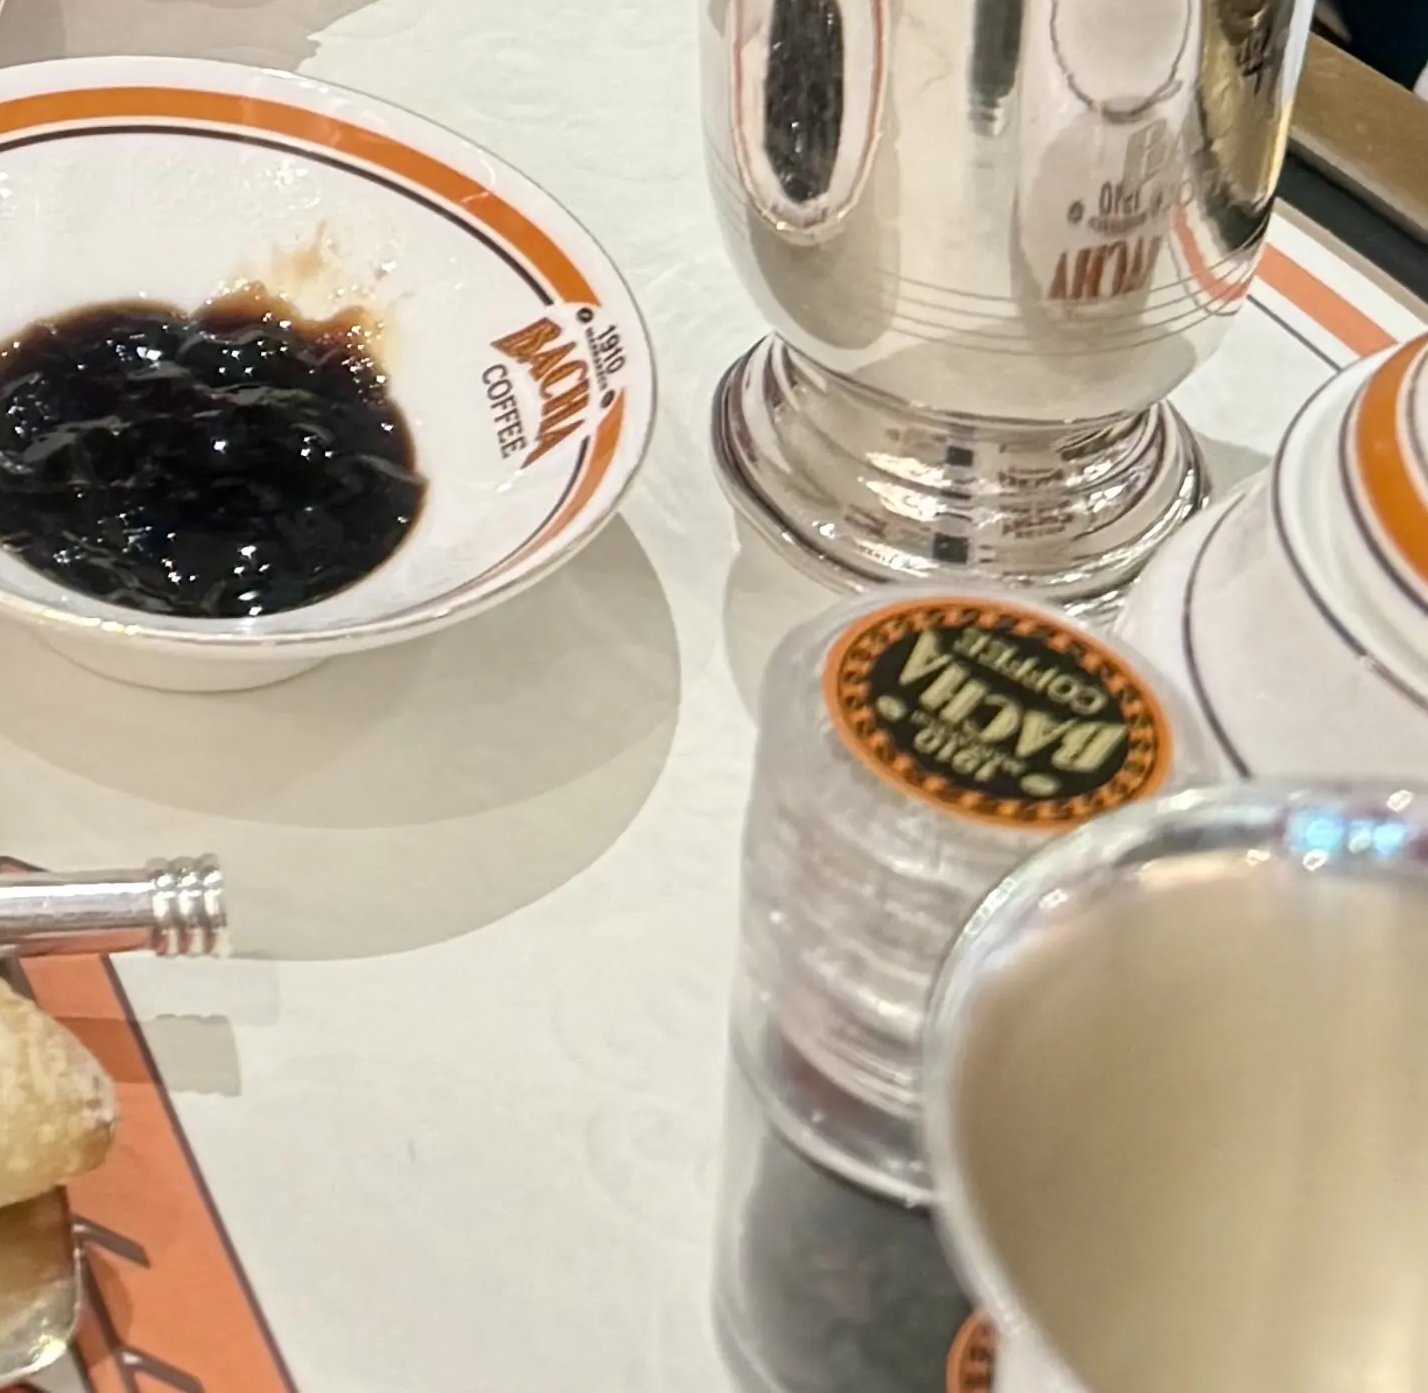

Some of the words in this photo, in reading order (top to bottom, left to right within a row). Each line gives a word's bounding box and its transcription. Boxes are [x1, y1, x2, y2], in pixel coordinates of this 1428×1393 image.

[489, 317, 590, 470] BACHA
[595, 324, 626, 374] 1910
[481, 363, 528, 460] COFFEE
[898, 628, 1127, 773] BACHA
